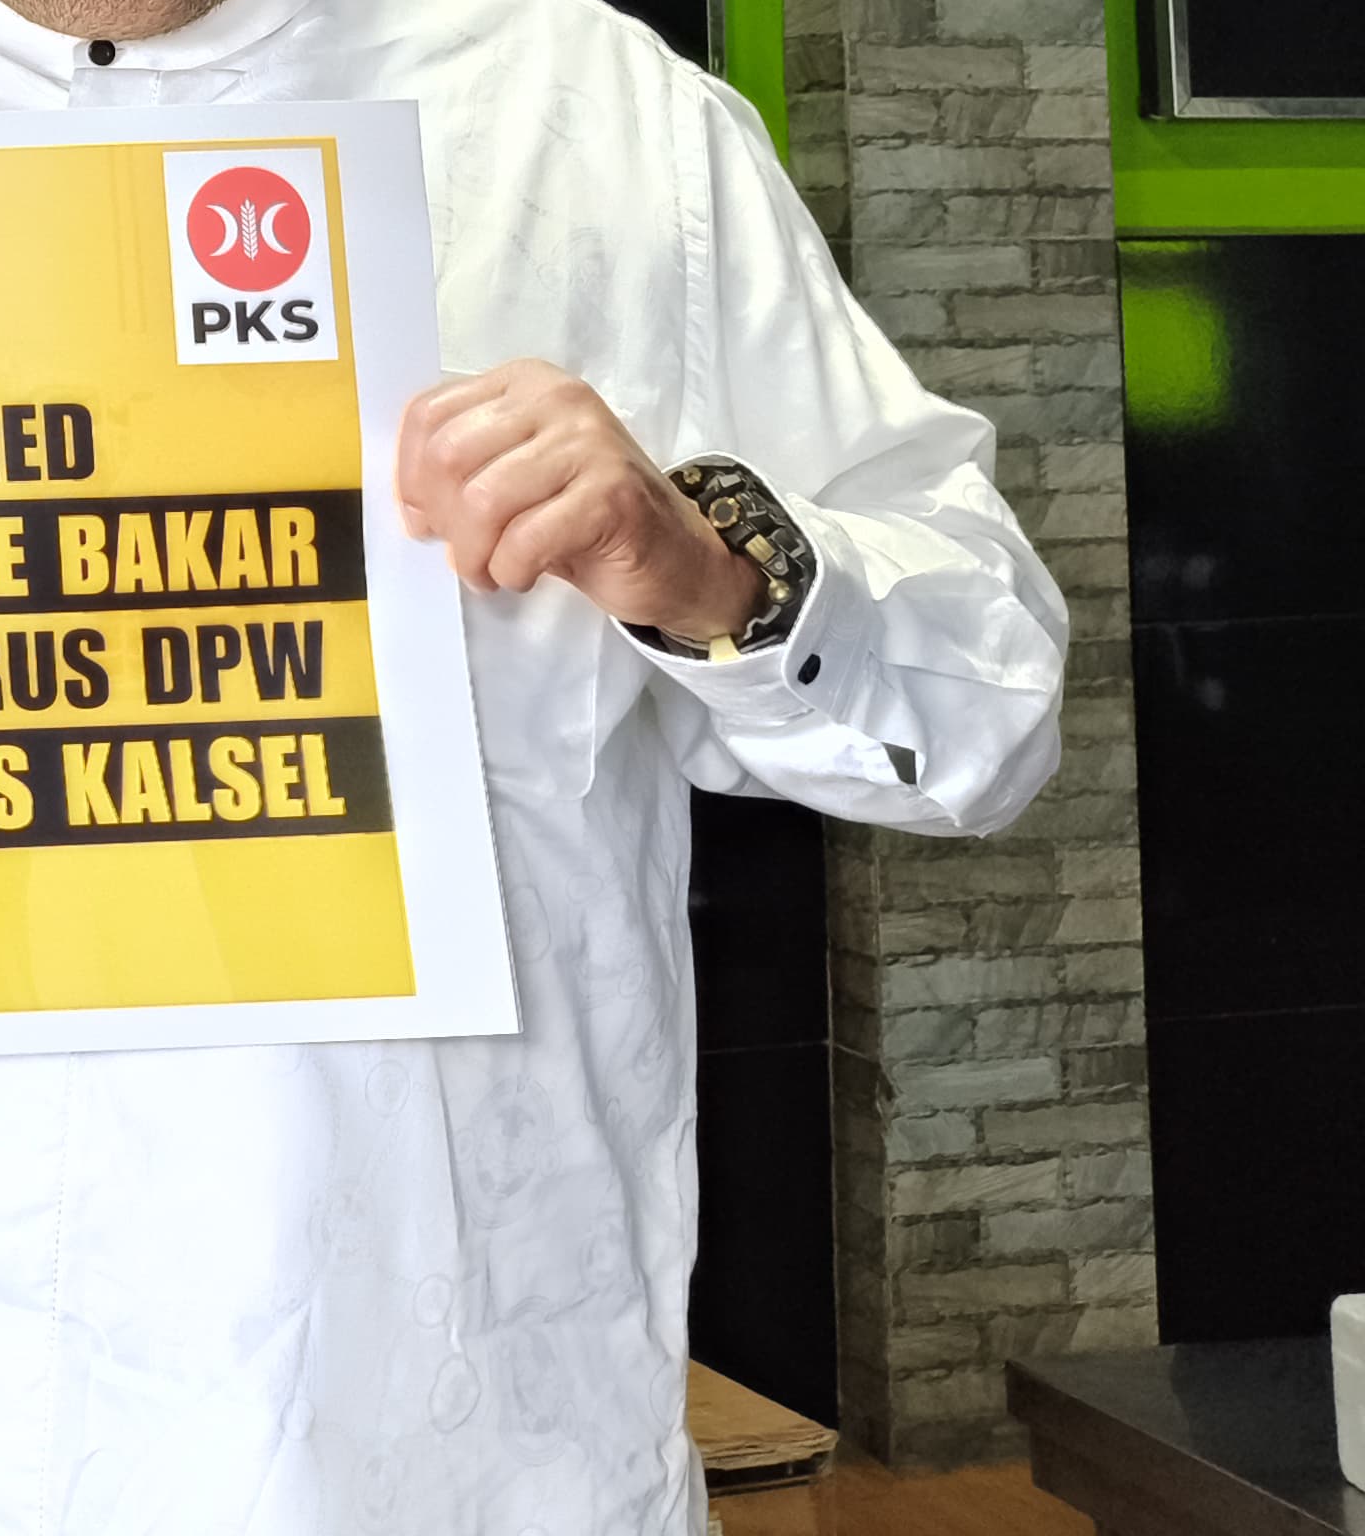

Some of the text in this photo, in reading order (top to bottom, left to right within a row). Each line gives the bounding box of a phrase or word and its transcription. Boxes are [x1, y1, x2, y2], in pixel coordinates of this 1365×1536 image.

[191, 299, 320, 345] PKS
[58, 506, 321, 597] BAKAR
[141, 620, 324, 707] DPW
[62, 733, 347, 827] KALSEL
